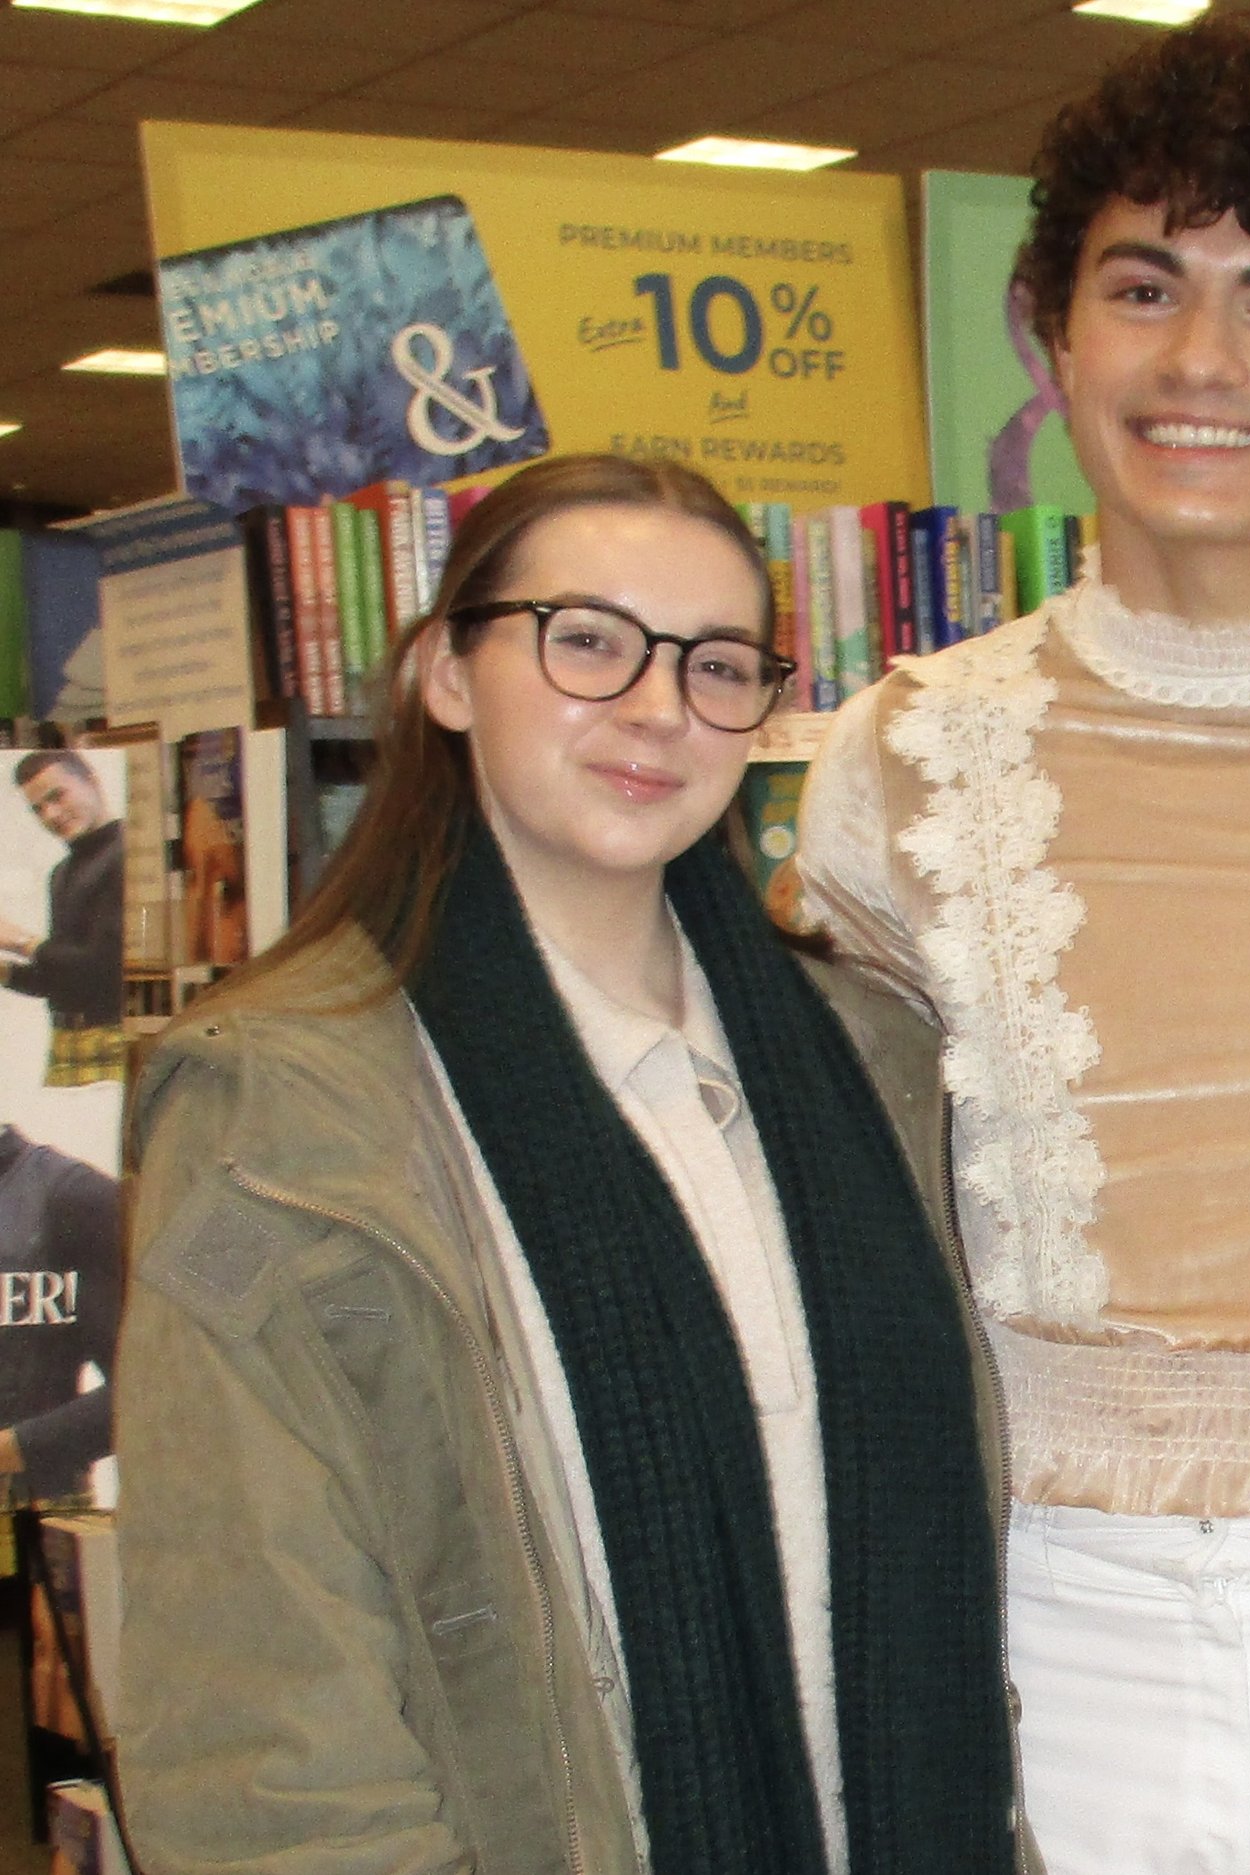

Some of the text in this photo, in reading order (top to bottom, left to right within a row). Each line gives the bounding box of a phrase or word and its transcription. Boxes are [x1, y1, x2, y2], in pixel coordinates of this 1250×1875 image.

[559, 222, 853, 264] PREMIUM MEMBERS
[577, 315, 645, 345] Extra
[769, 347, 847, 381] OFF
[391, 322, 526, 457] &
[610, 433, 847, 466] EARN REWARDS
[0, 1270, 79, 1326] ER!
